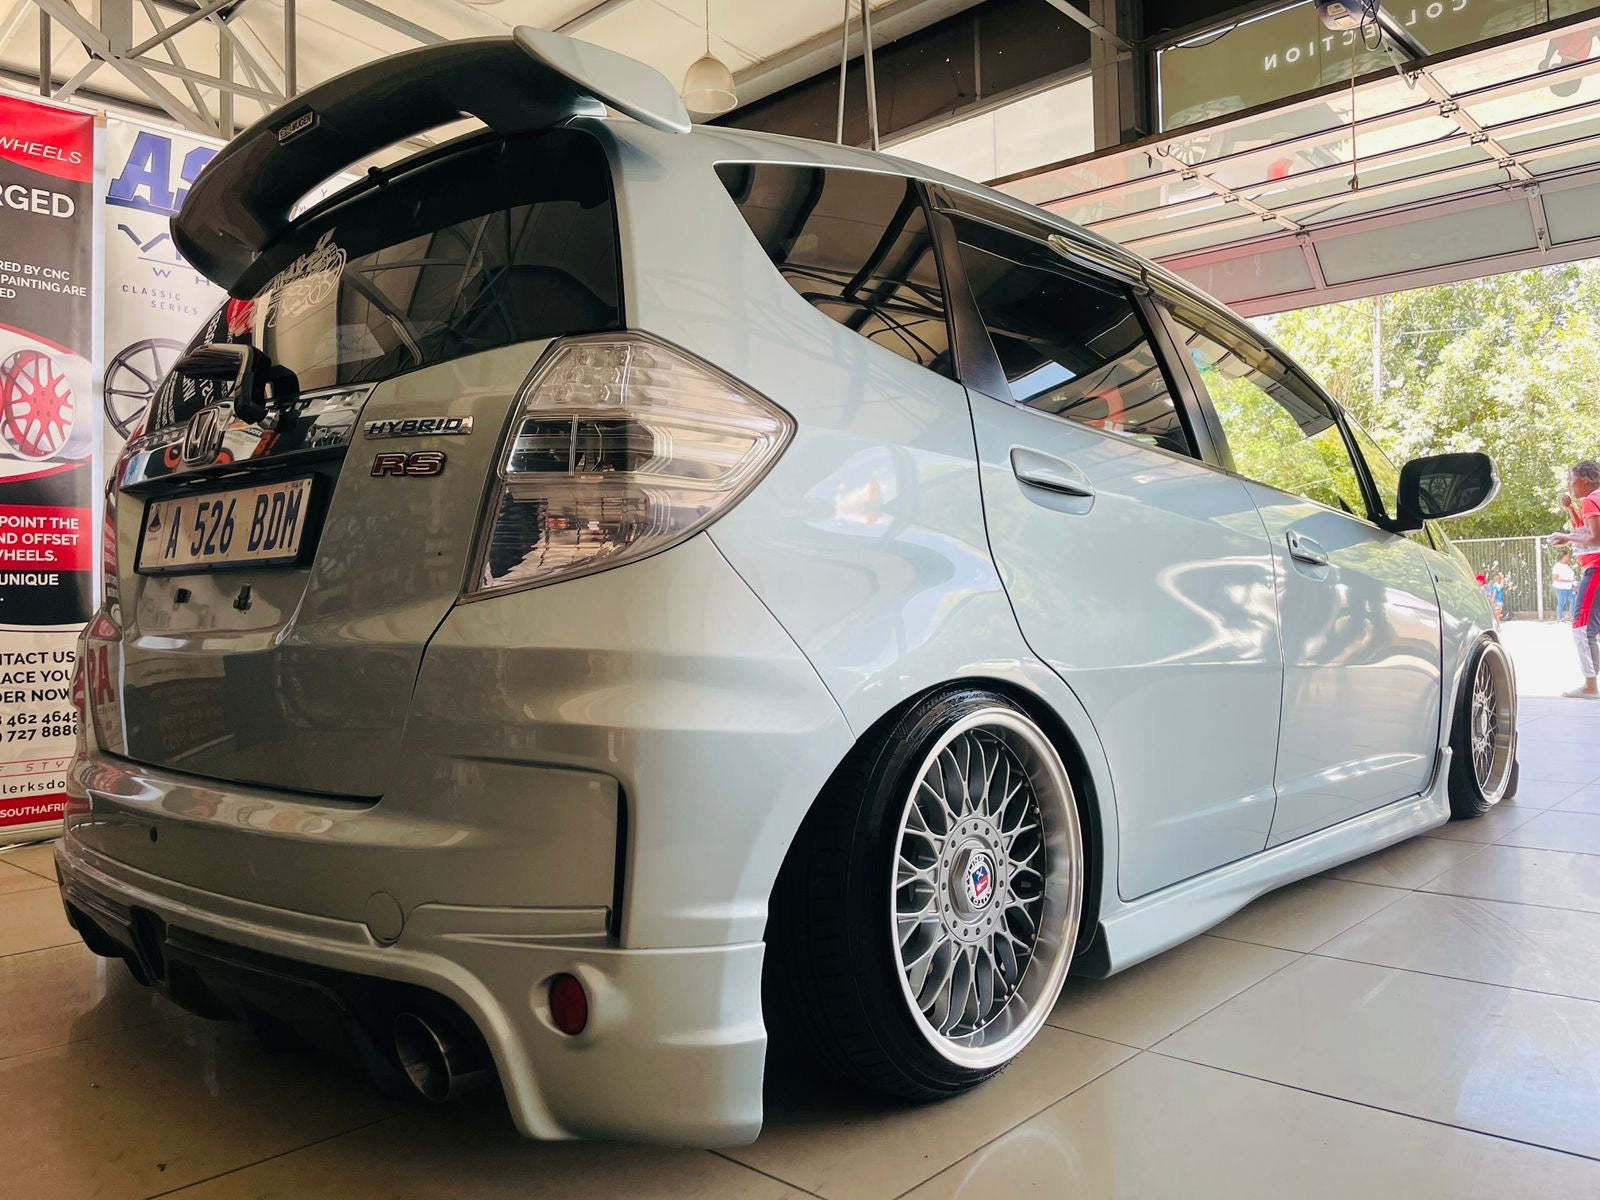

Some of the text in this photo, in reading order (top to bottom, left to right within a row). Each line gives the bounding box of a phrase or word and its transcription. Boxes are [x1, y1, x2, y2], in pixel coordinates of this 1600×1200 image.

[0, 136, 82, 164] WHEELS
[0, 184, 75, 218] GED
[24, 265, 41, 275] BY
[43, 268, 70, 281] CNC
[1, 274, 87, 296] PAINTING ARE
[122, 284, 181, 301] CLASSIC
[151, 300, 198, 315] SERIES
[368, 417, 464, 435] HYBRID
[371, 452, 446, 476] RS
[0, 515, 79, 529] POINT THE
[164, 487, 304, 560] A 526 BDM
[22, 532, 80, 545] OFFSET
[0, 549, 58, 562] HEELS.
[0, 573, 59, 587] UNIQUE
[0, 652, 48, 666] TACT
[7, 713, 37, 727] 462
[7, 728, 37, 742] 727
